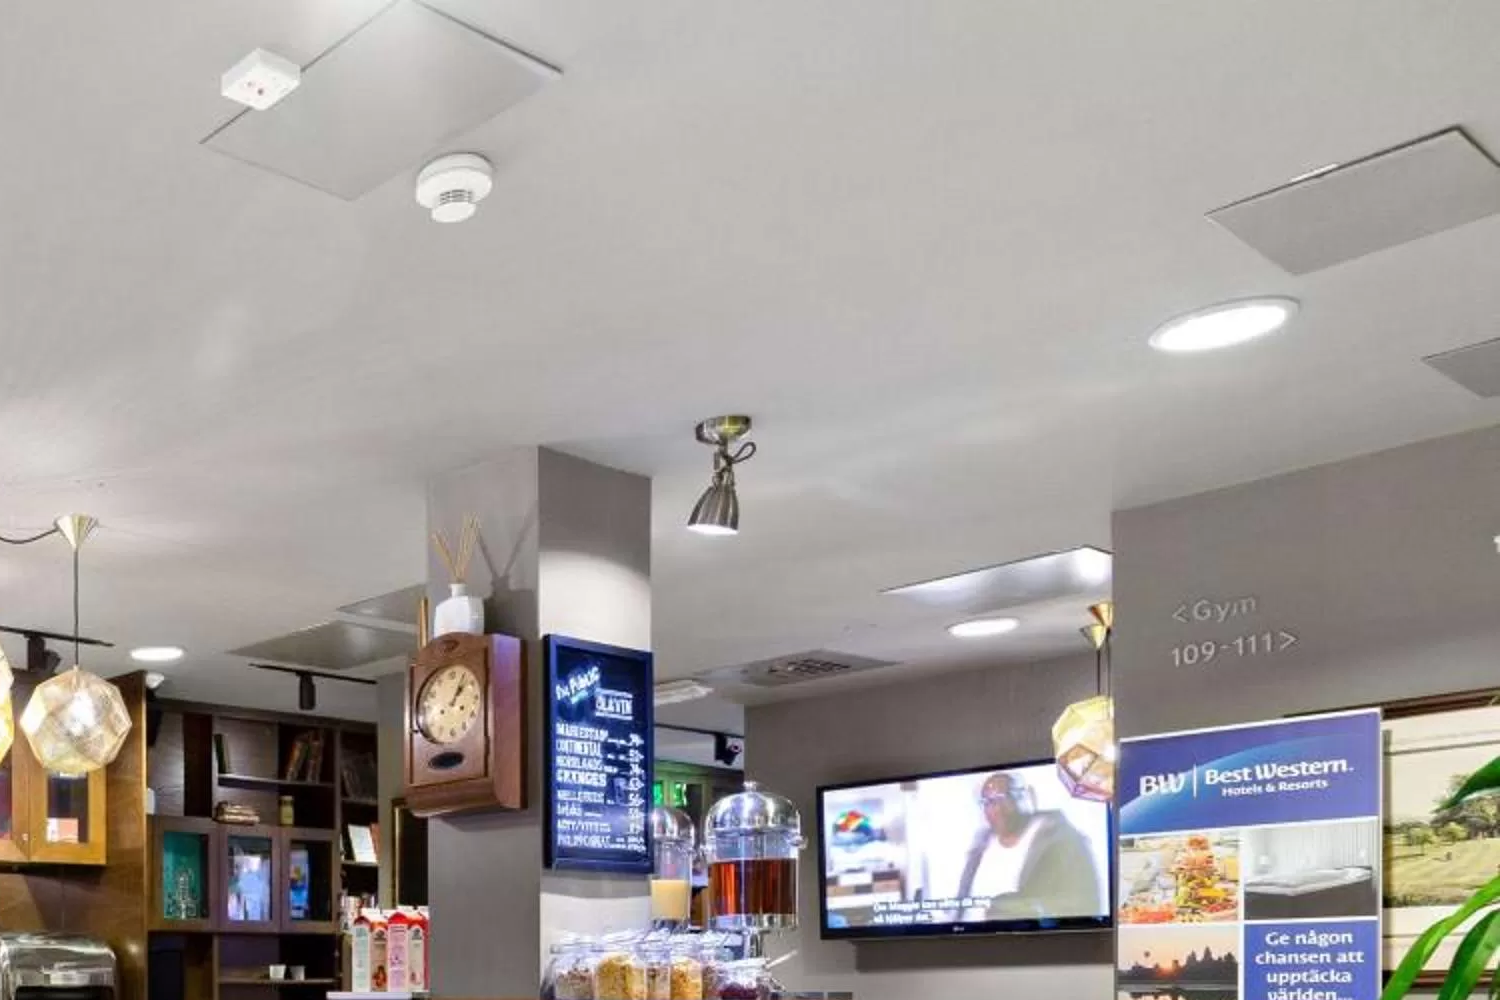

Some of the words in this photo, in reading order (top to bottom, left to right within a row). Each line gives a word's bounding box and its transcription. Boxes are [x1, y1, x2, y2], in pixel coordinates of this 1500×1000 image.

[1139, 771, 1186, 797] BW
[1205, 767, 1253, 786] Best
[1221, 783, 1263, 797] Hotels
[1265, 782, 1277, 793] &
[1279, 778, 1329, 792] Resorts
[1265, 931, 1290, 946] Ge
[1295, 929, 1353, 947] någon
[1255, 951, 1331, 965] chansen
[1336, 951, 1365, 963] att
[1266, 969, 1353, 987] upptäcka
